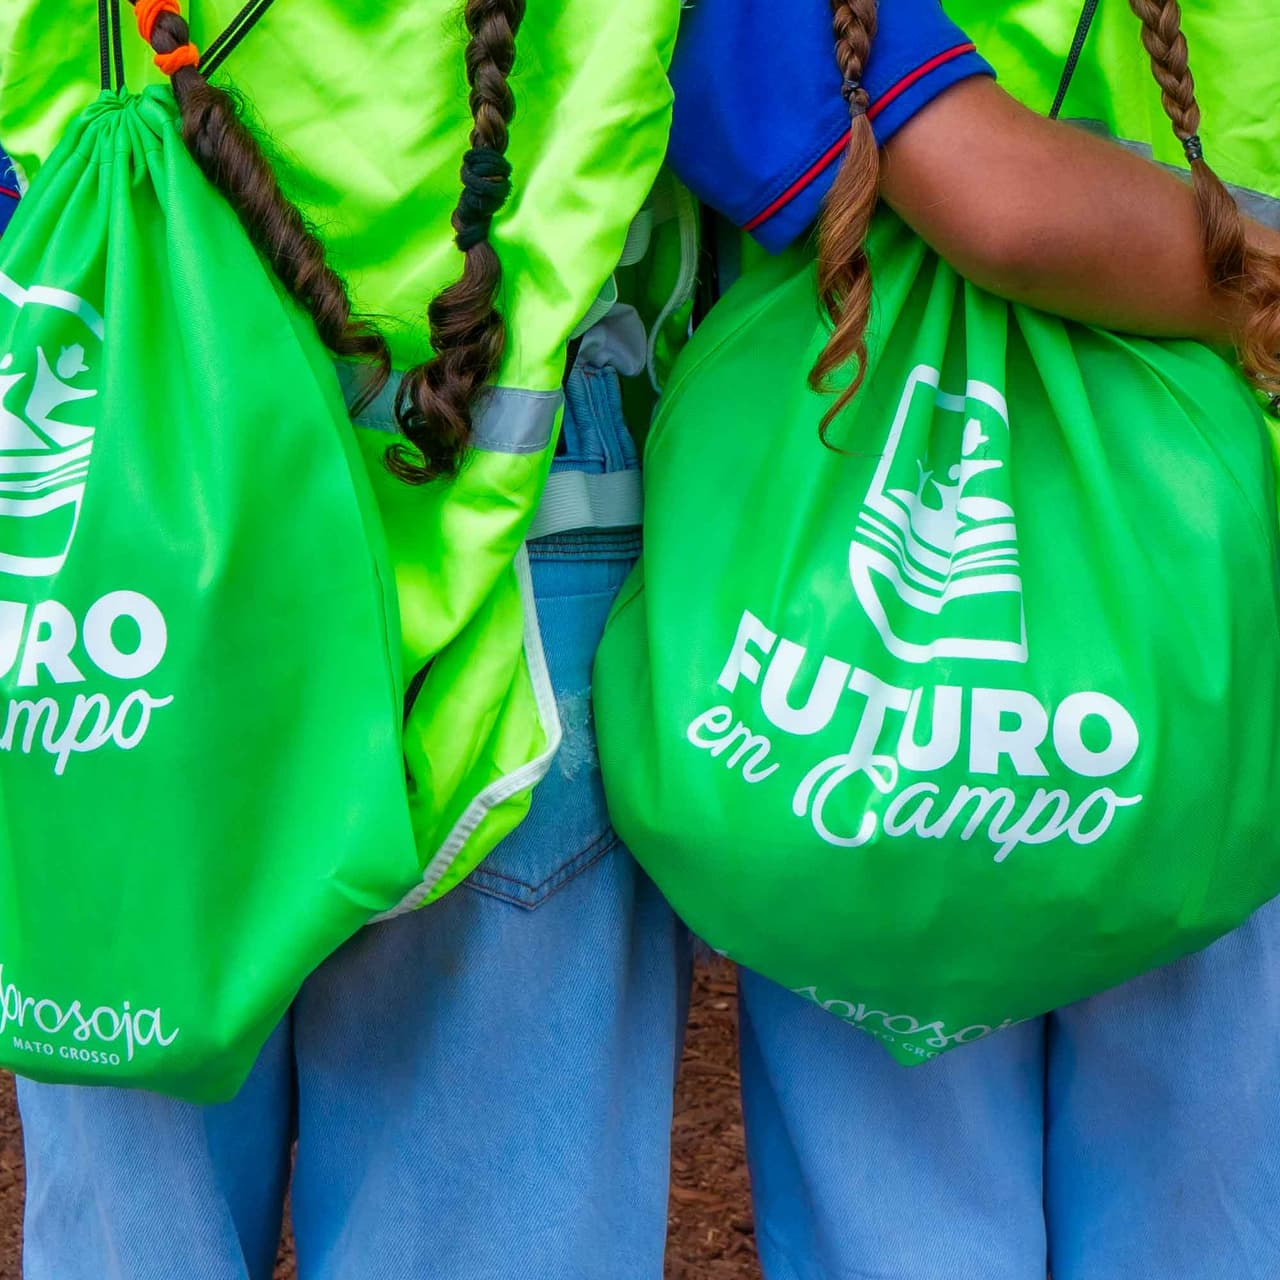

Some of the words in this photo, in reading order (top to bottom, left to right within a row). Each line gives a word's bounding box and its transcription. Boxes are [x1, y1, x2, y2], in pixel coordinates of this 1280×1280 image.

[717, 608, 1140, 778] FUTURO
[686, 705, 780, 784] em
[792, 754, 1143, 863] Campo
[13, 1036, 54, 1056] MATO
[59, 1046, 120, 1066] GROSSO
